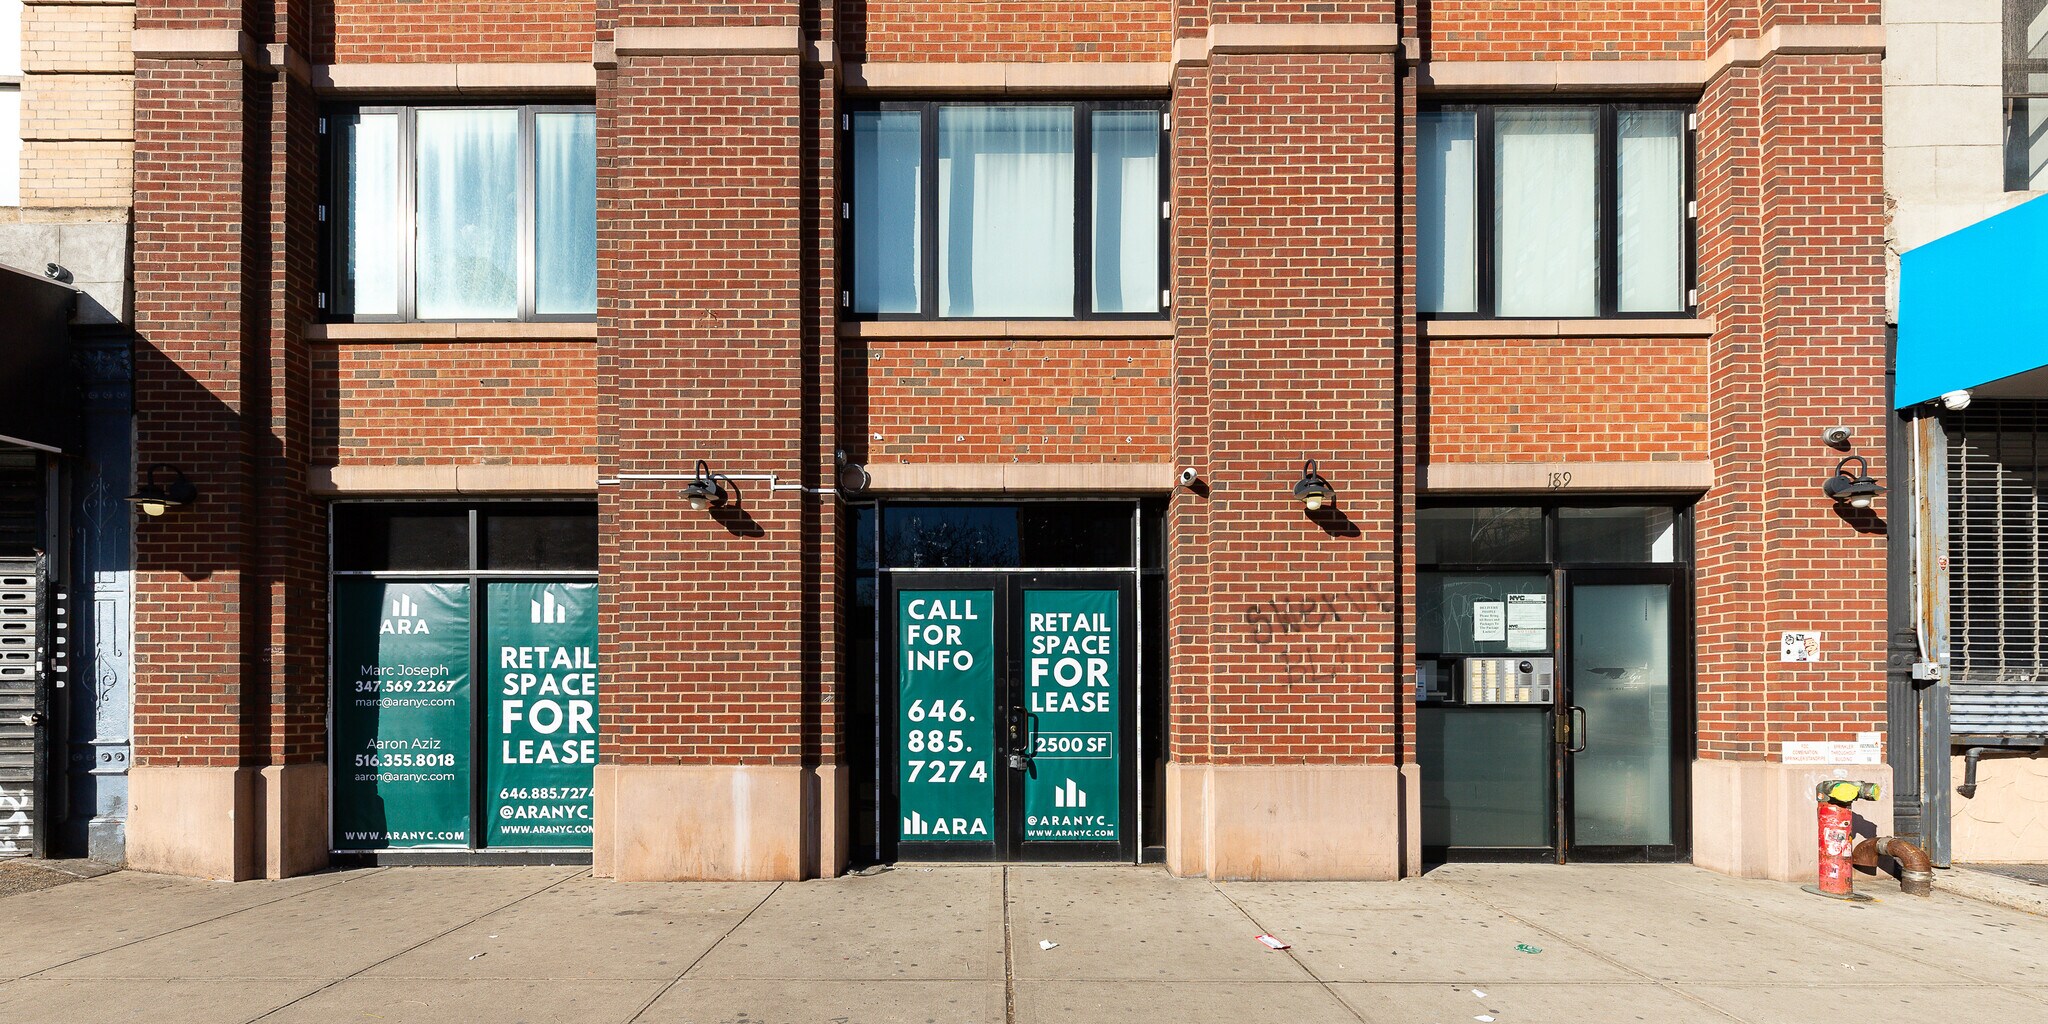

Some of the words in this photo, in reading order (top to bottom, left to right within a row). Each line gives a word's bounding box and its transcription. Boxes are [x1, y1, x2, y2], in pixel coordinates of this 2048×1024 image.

[1548, 472, 1571, 490] 189
[908, 600, 977, 620] CALL
[380, 619, 430, 635] ARA
[1030, 613, 1111, 632] RETAIL
[908, 625, 962, 646] FOR
[1031, 636, 1110, 655] SPACE
[501, 647, 596, 669] RETAIL
[908, 650, 974, 671] INFO
[361, 665, 394, 676] Marc
[397, 664, 449, 679] Joseph
[1031, 658, 1110, 687] FOR
[355, 680, 455, 693] 347.569.2267
[503, 674, 595, 696] SPACE
[356, 697, 455, 708] marc@aranyc.com
[908, 699, 975, 722] 646.
[1031, 692, 1110, 713] LEASE
[502, 700, 595, 734] FOR
[367, 739, 408, 750] Aaron
[411, 739, 441, 750] Aziz
[908, 730, 972, 752] 885.
[1036, 738, 1083, 752] 2500
[1086, 738, 1107, 752] SF
[355, 754, 455, 767] 516.355.8018
[503, 740, 595, 764] LEASE
[355, 771, 455, 782] aaron@aranyc.com
[908, 760, 987, 783] 7274
[500, 806, 594, 820] @ARANYC_
[1028, 816, 1114, 826] @ARANYC_
[345, 831, 464, 840] WWW.ARANYC.COM
[932, 818, 987, 834] ARA
